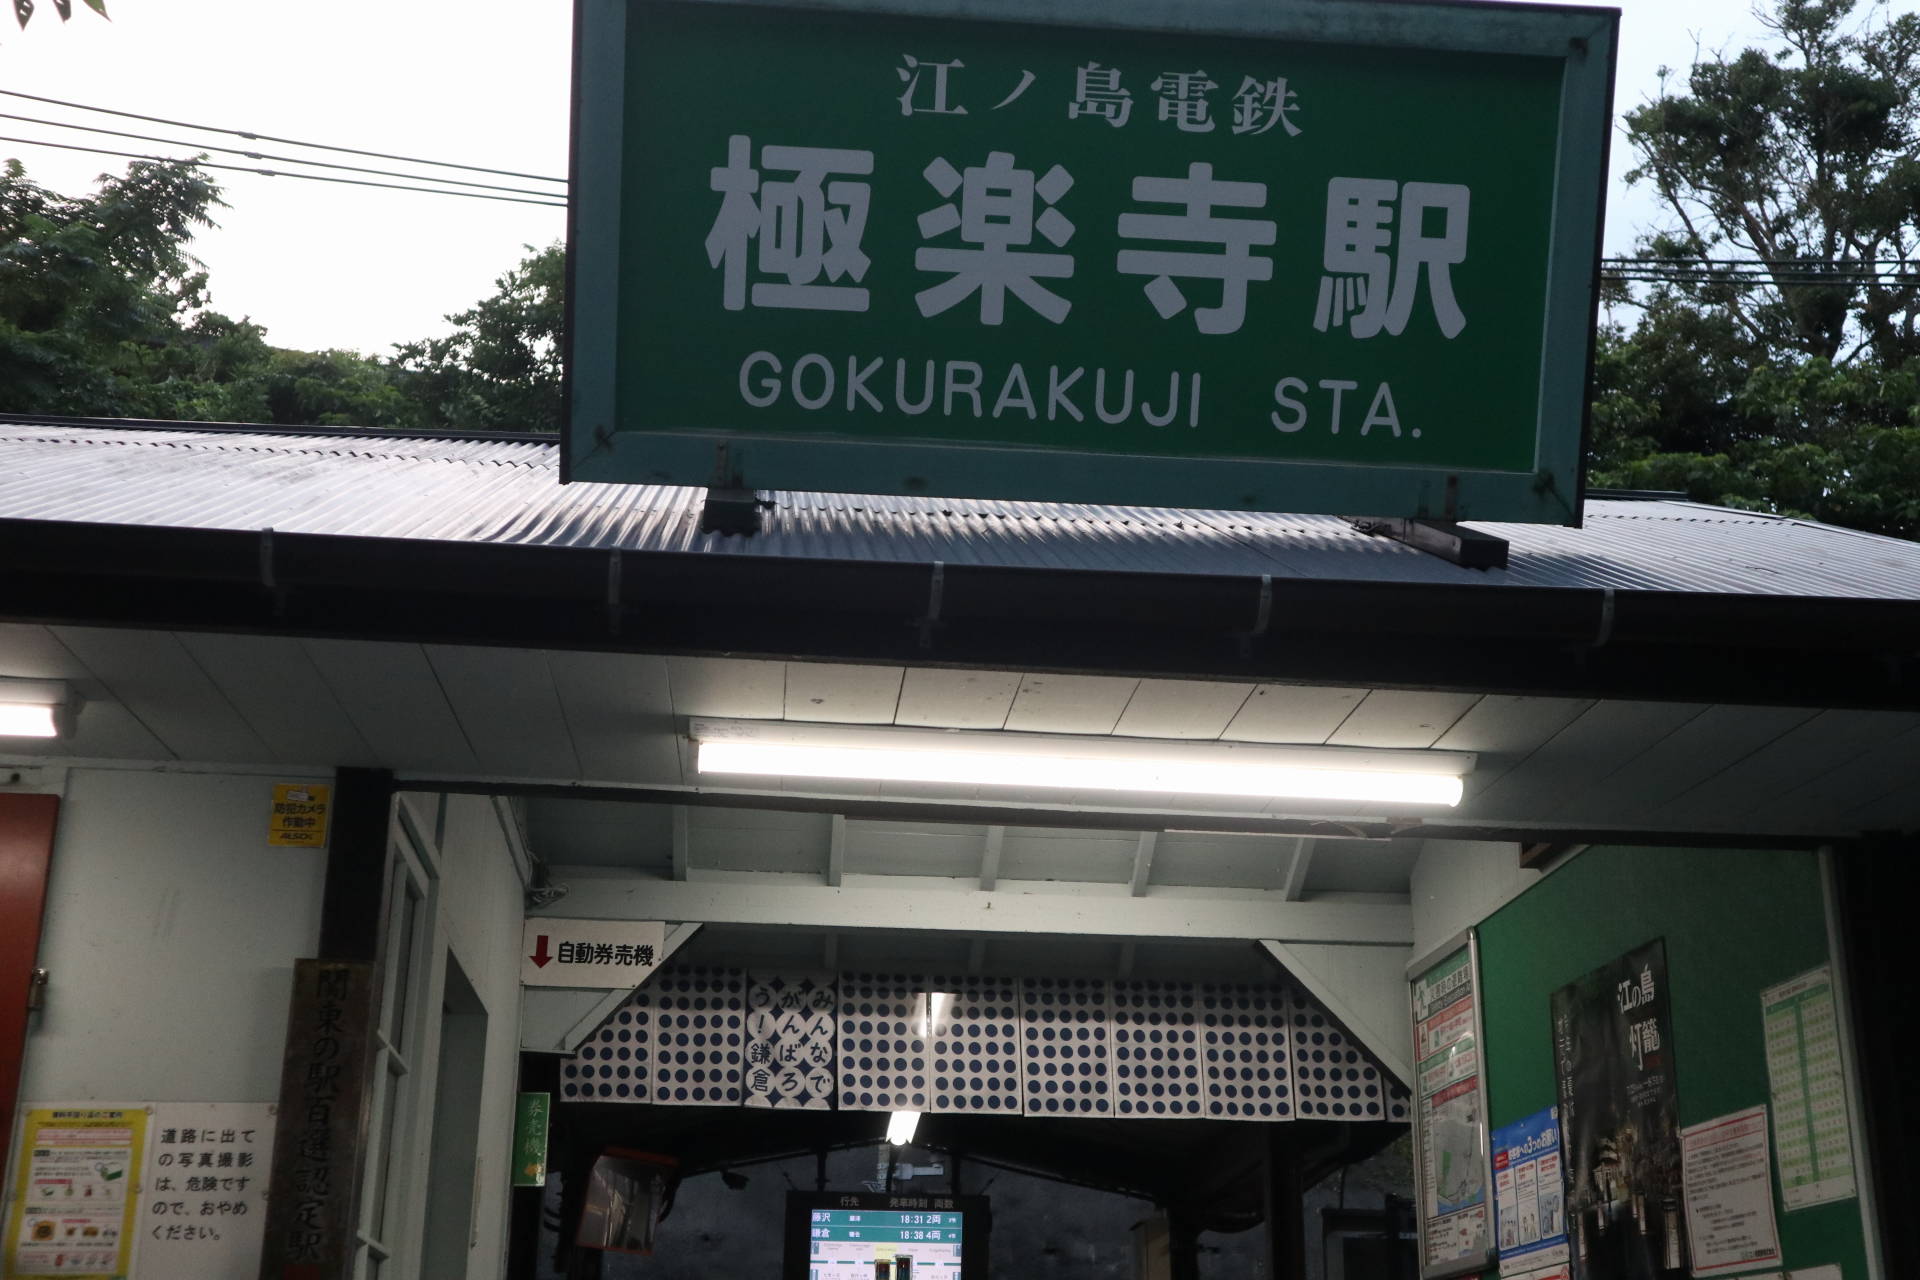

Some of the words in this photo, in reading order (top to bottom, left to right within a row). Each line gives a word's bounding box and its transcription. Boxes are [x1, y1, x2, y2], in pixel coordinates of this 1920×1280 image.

[895, 53, 1304, 137] 江ノ島電鉄
[704, 133, 1472, 340] 極楽寺駅
[738, 349, 1201, 429] GOKURAKUJI
[1270, 375, 1424, 440] STA.
[557, 941, 654, 967] 自動券売機
[1616, 963, 1655, 1014] 江の島
[1629, 1017, 1661, 1072] 灯籠
[160, 1127, 256, 1145] 道路に出て
[157, 1151, 254, 1169] の写真撮影
[154, 1176, 251, 1192] は、危険です
[151, 1201, 249, 1217] ので、おやめ
[840, 1196, 860, 1207] 行先
[934, 1199, 954, 1209] 両数
[812, 1212, 831, 1223] 藤沢
[900, 1214, 923, 1224] 18:31
[151, 1225, 223, 1242] ください。
[900, 1230, 923, 1240] 18:38
